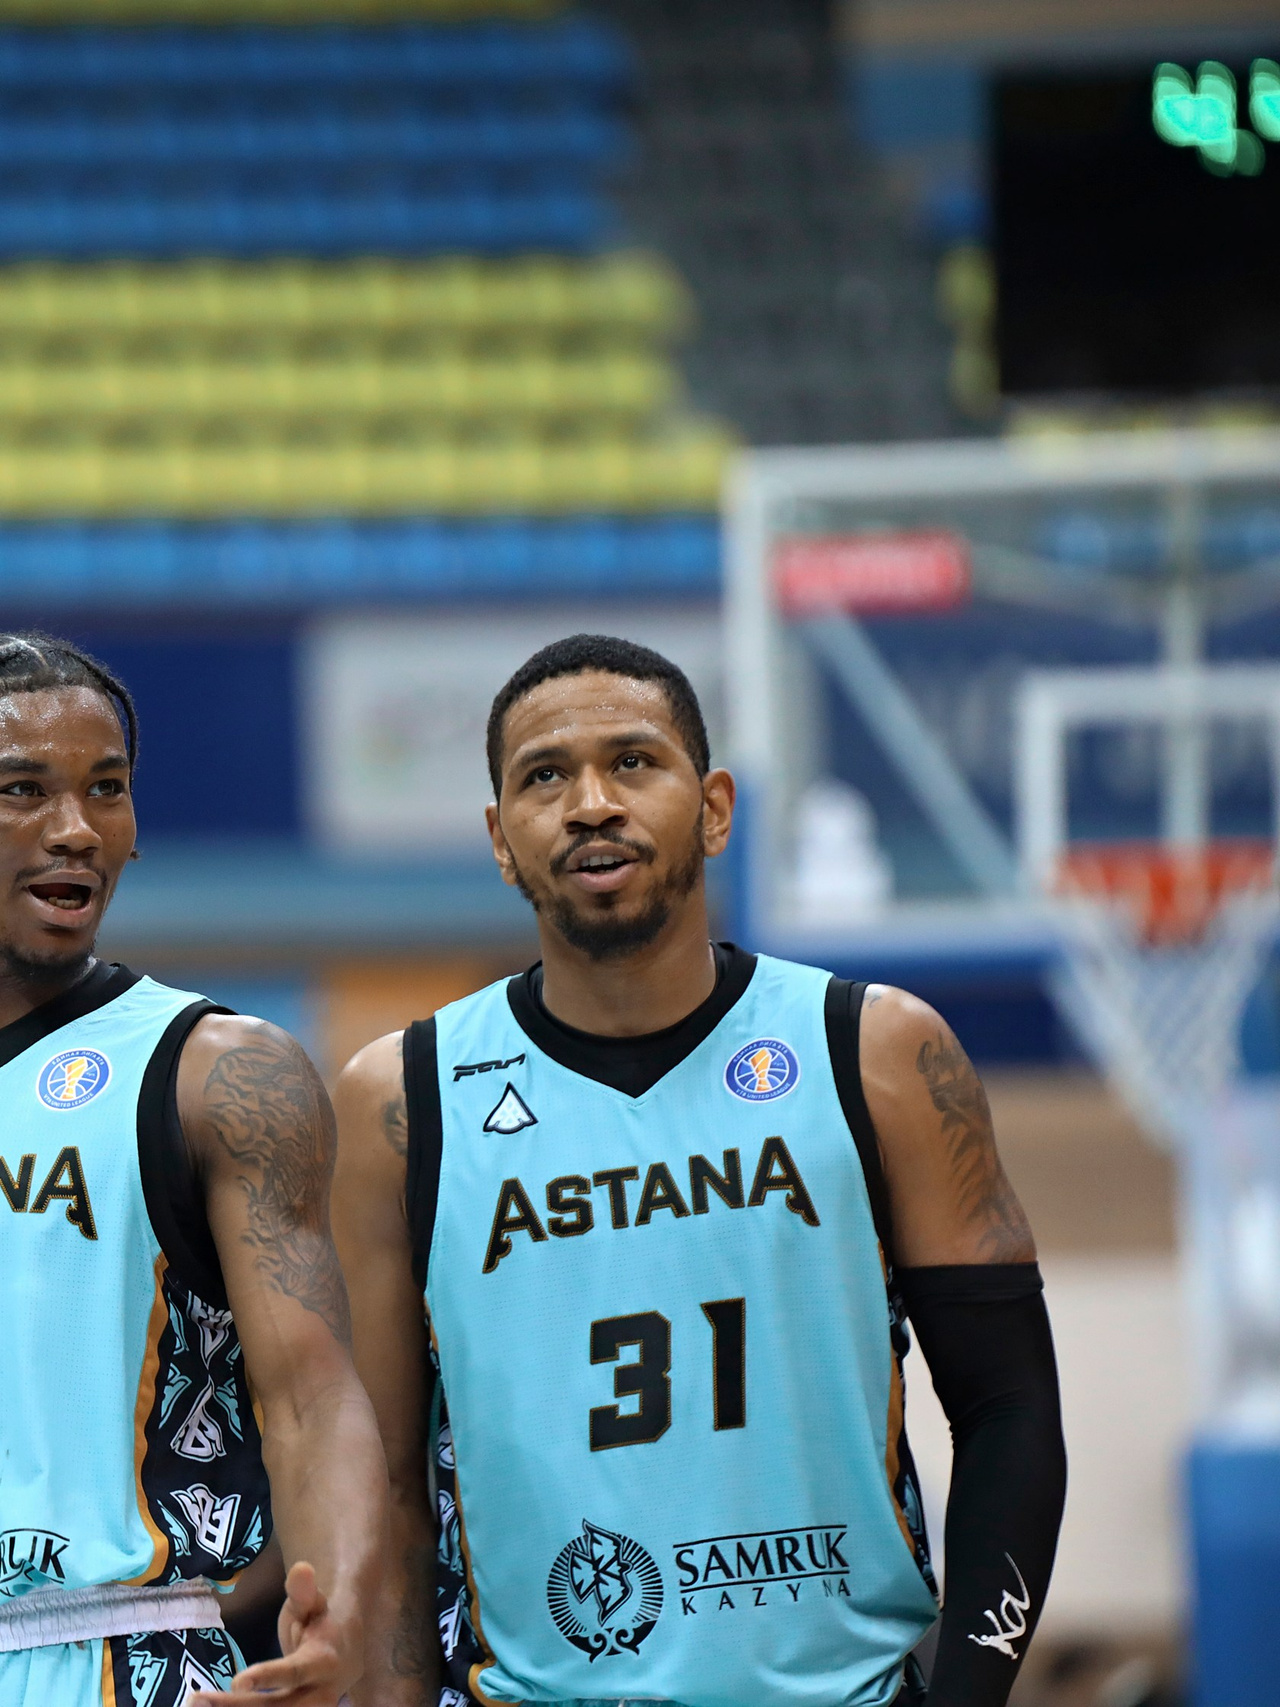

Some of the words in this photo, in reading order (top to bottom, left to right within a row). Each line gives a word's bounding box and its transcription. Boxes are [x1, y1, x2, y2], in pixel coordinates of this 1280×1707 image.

[482, 1136, 821, 1274] ASTANA
[590, 1297, 746, 1452] 31
[675, 1531, 850, 1587] SAMRUK
[681, 1578, 851, 1616] KAZYNA
